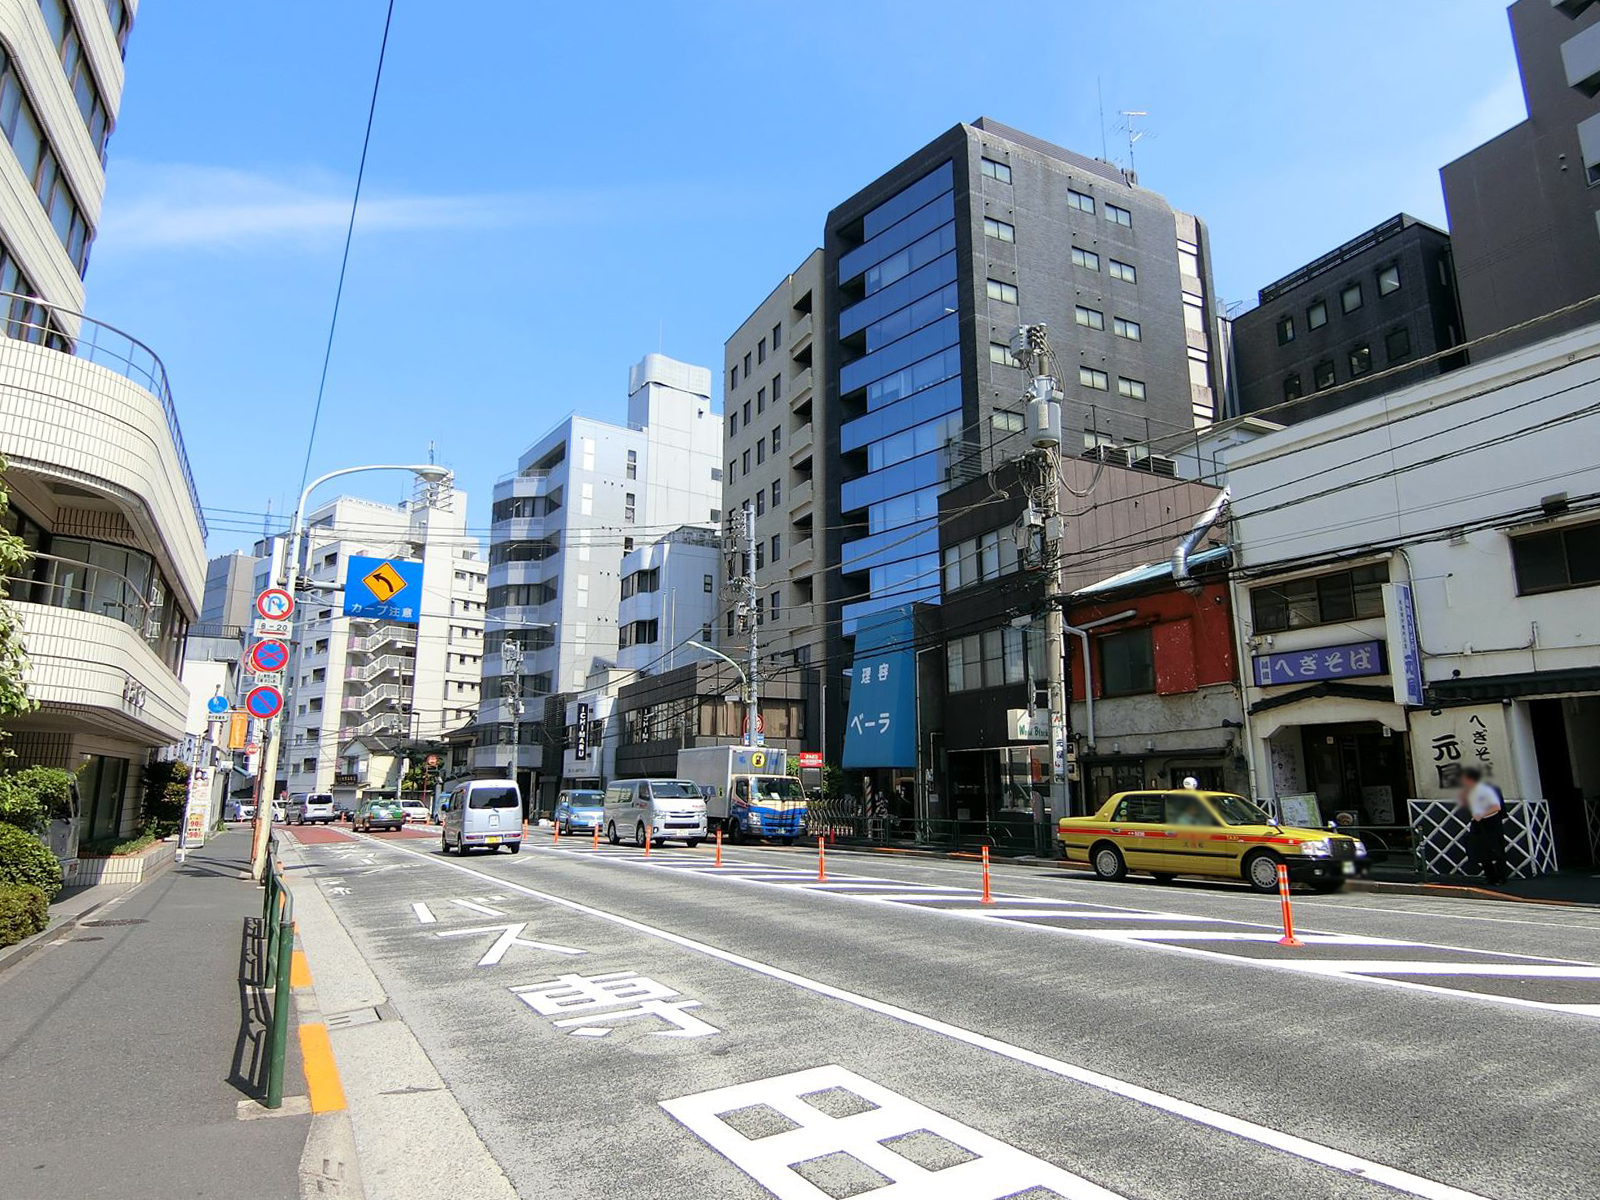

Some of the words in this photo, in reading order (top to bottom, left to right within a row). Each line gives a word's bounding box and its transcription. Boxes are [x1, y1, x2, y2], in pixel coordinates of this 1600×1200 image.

[351, 603, 413, 618] カーブ注意
[1275, 648, 1371, 676] へぎそば
[861, 663, 889, 684] 理容
[578, 706, 586, 757] ICHIMARU
[851, 713, 890, 735] ベーラ
